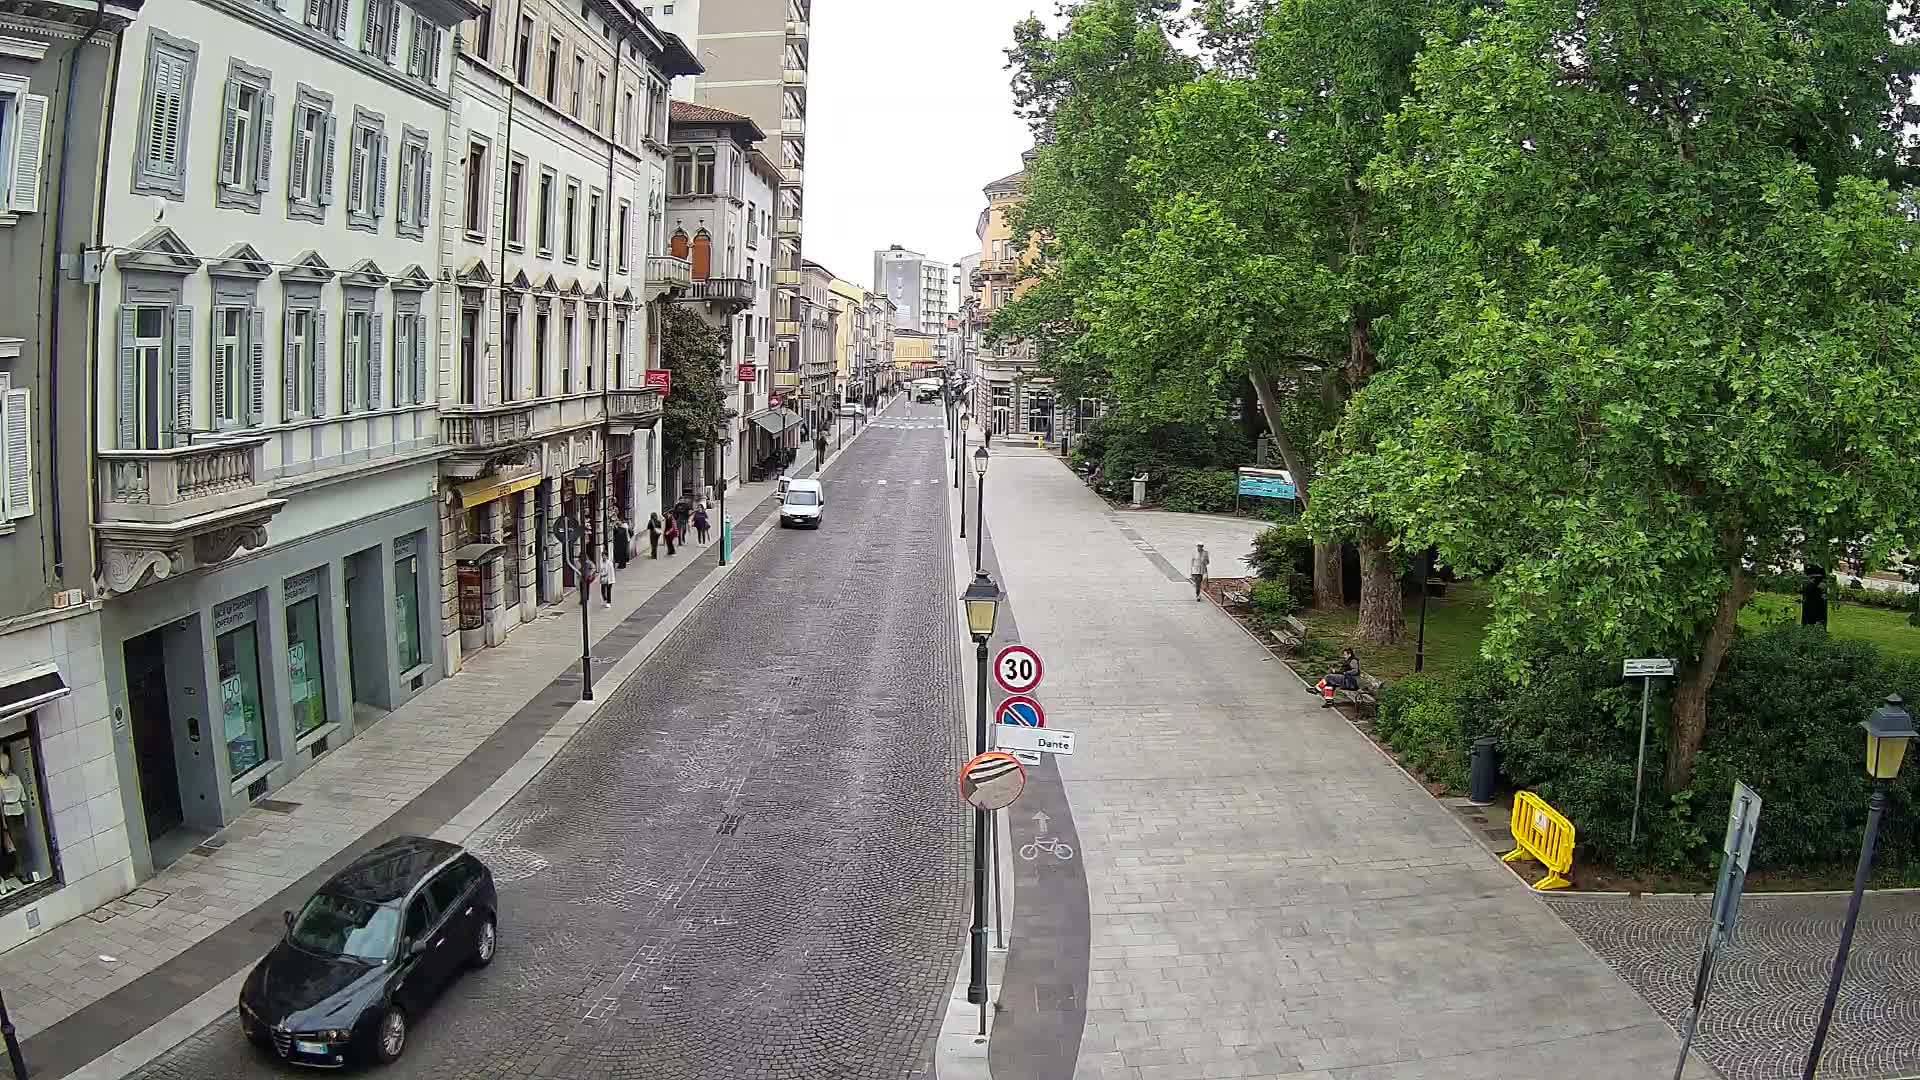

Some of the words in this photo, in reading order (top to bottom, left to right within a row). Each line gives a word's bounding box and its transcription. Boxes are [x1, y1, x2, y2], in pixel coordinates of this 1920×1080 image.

[1005, 659, 1032, 680] 30
[222, 678, 239, 701] 130
[1038, 738, 1069, 750] Dante
